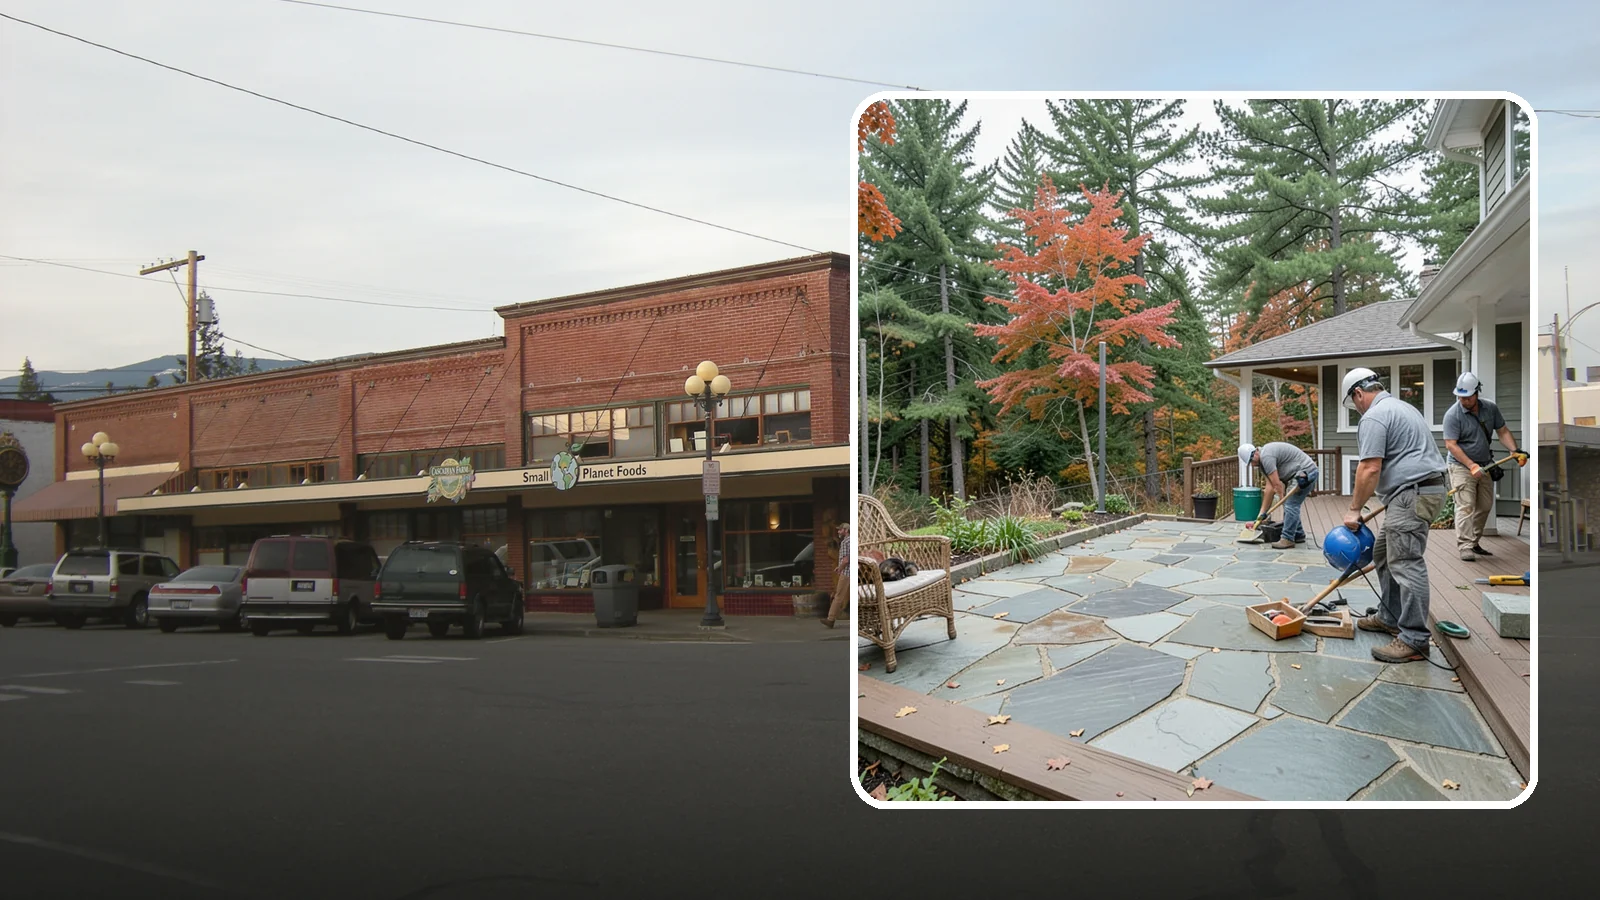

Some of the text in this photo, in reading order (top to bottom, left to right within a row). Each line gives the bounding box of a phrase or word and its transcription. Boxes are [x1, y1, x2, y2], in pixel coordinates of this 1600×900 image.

[523, 464, 647, 483] Small Planet Foods
